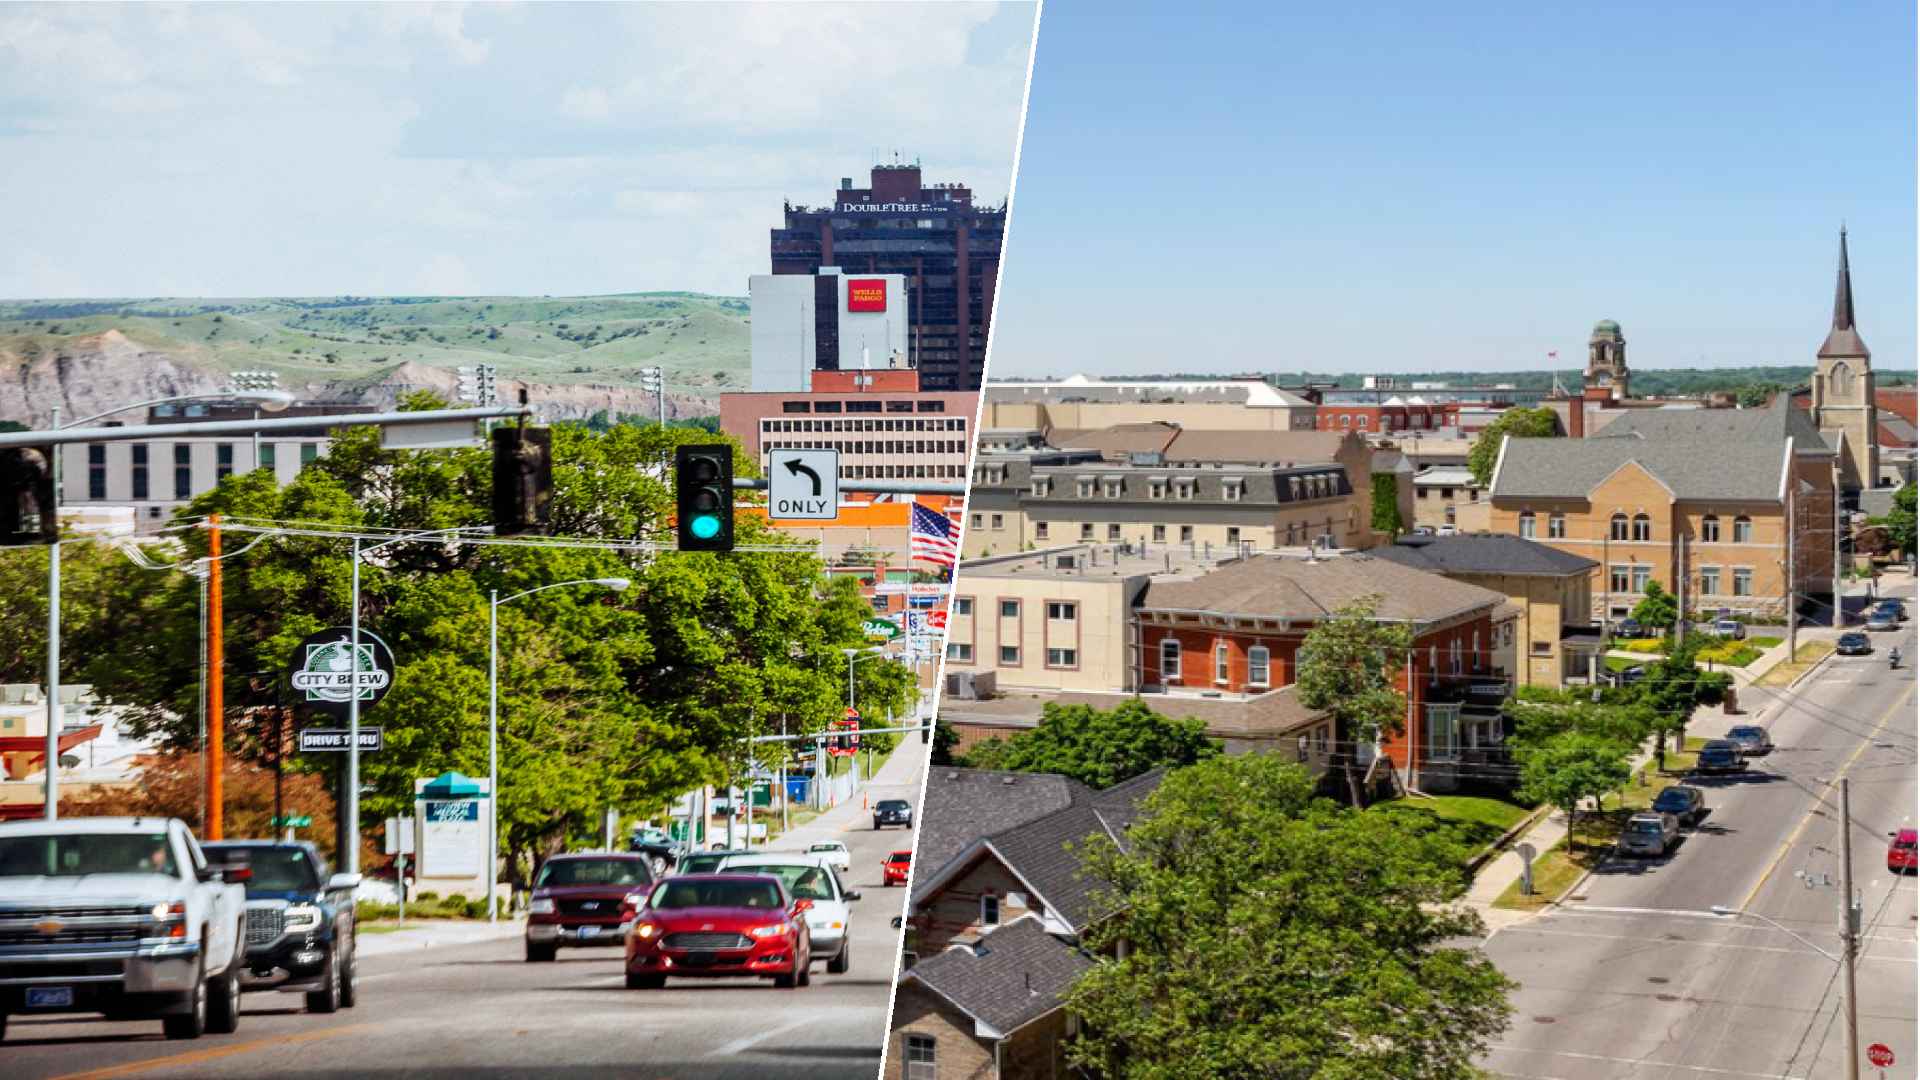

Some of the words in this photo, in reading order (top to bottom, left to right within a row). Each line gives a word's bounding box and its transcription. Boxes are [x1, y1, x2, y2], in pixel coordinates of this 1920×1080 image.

[778, 499, 828, 513] ONLY
[297, 674, 333, 685] CITY
[303, 734, 341, 746] DRIVE
